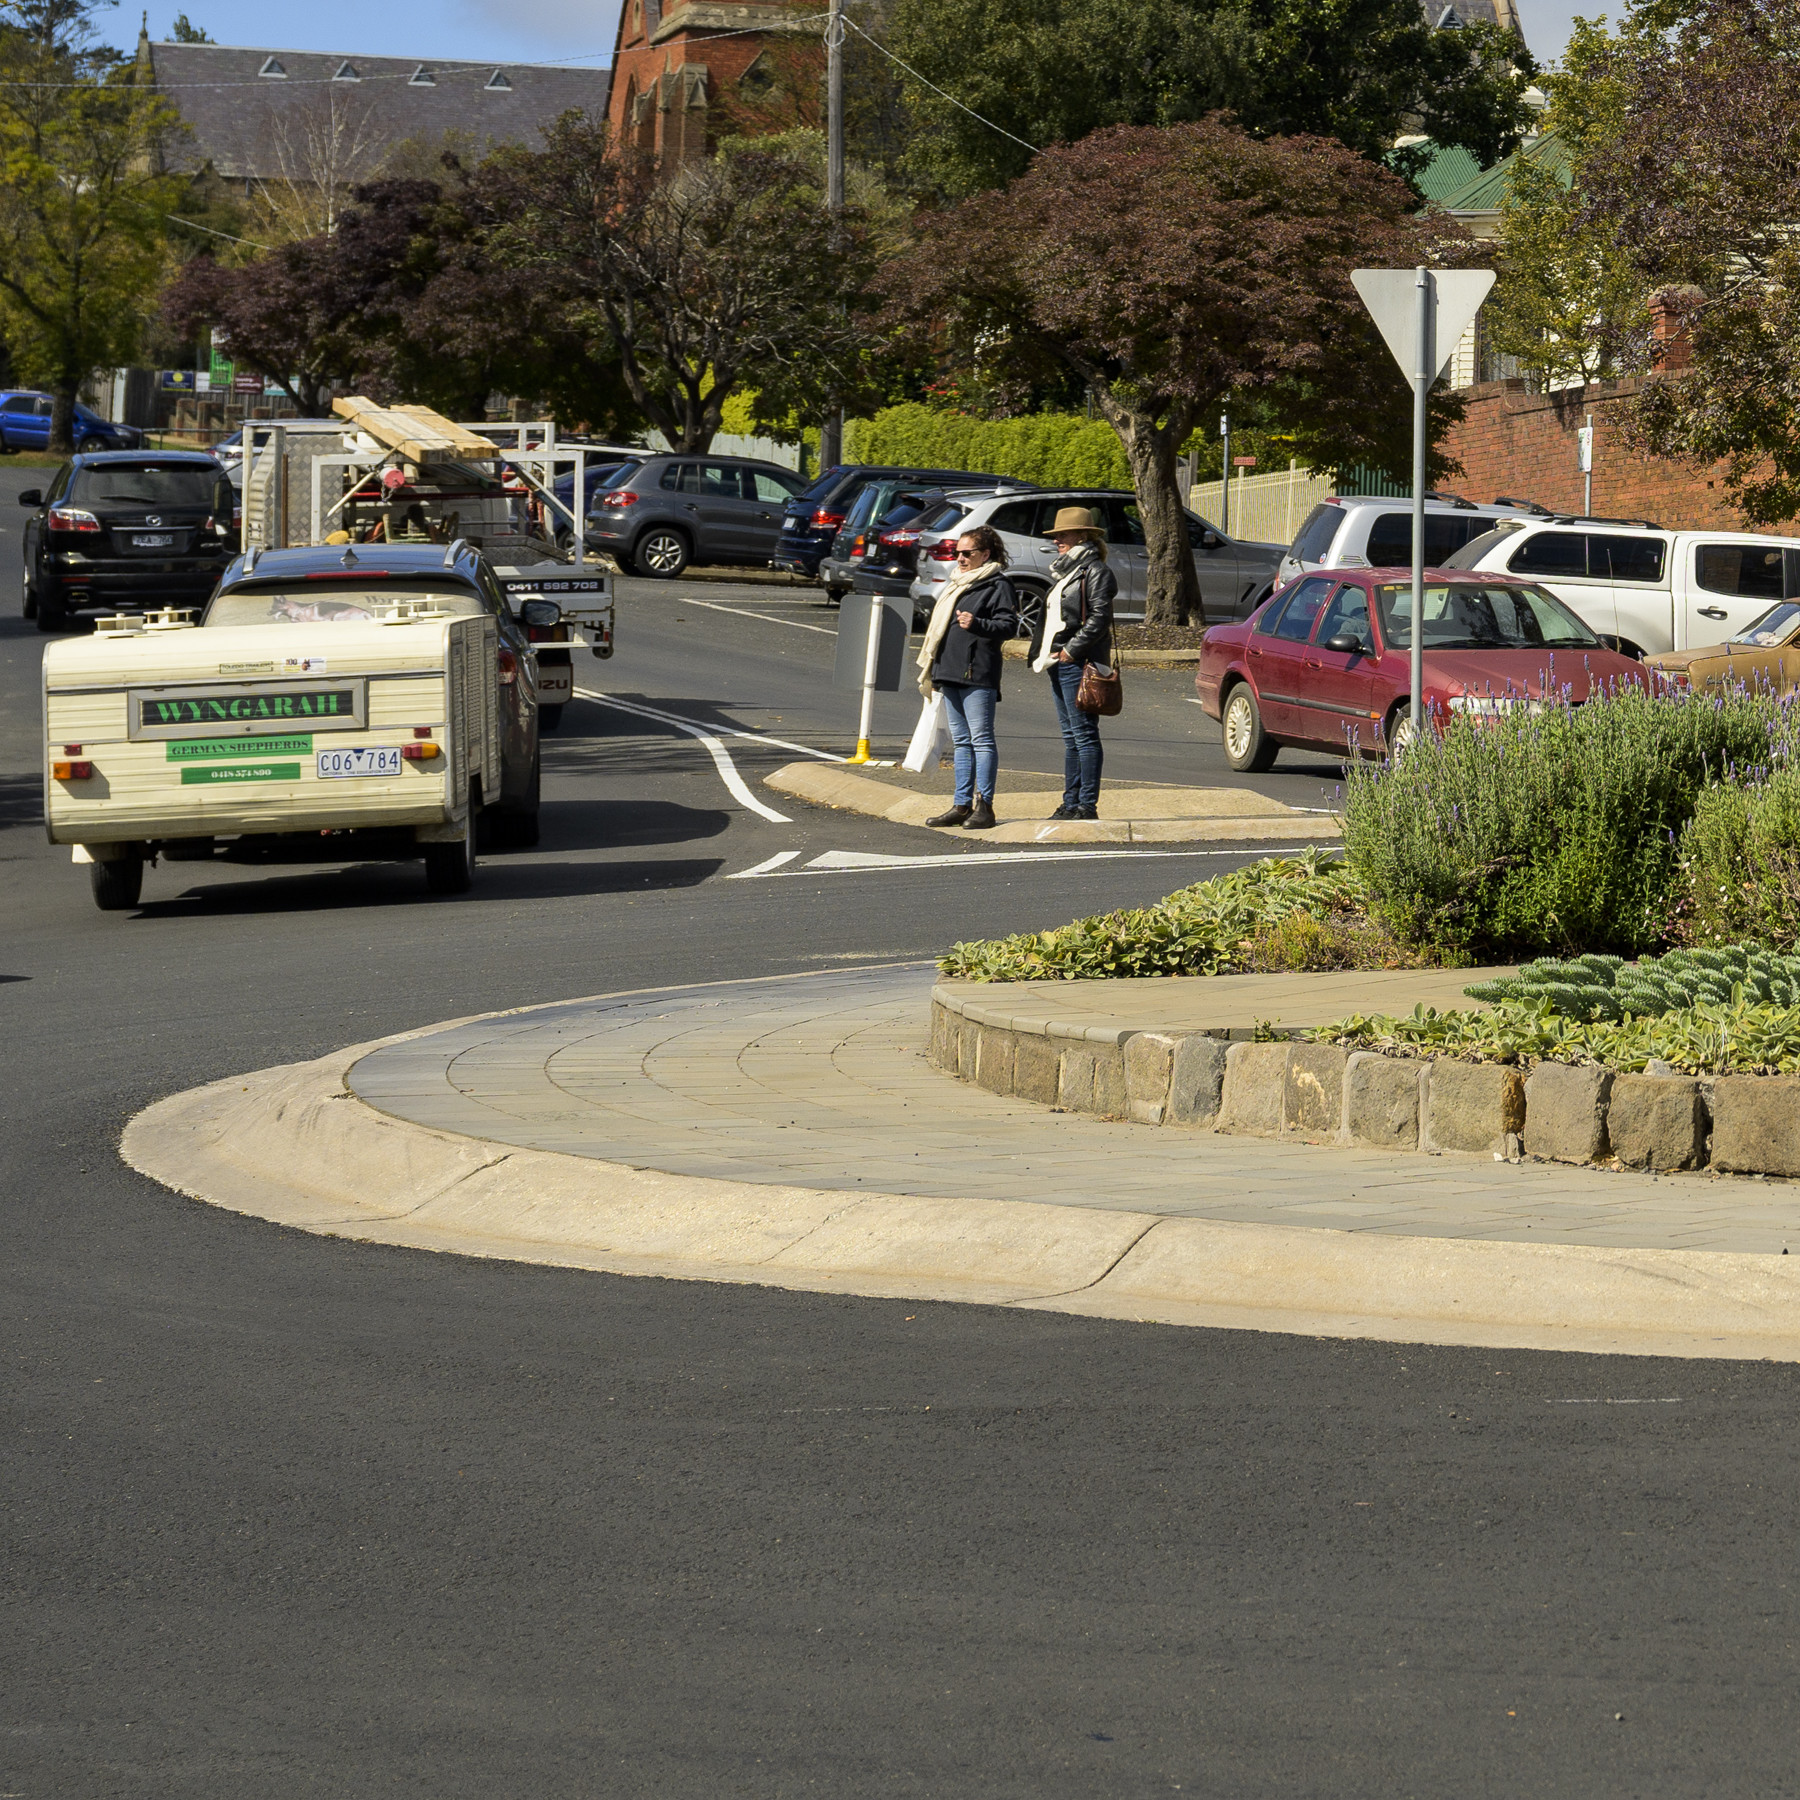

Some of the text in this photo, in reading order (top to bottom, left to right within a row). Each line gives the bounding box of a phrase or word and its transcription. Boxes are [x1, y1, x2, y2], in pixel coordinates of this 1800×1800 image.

[506, 582, 539, 591] 0411
[572, 581, 598, 590] 702
[156, 694, 340, 723] WYNGARAH
[172, 740, 309, 756] GERMAN SHEPHERDS
[367, 751, 398, 770] 784
